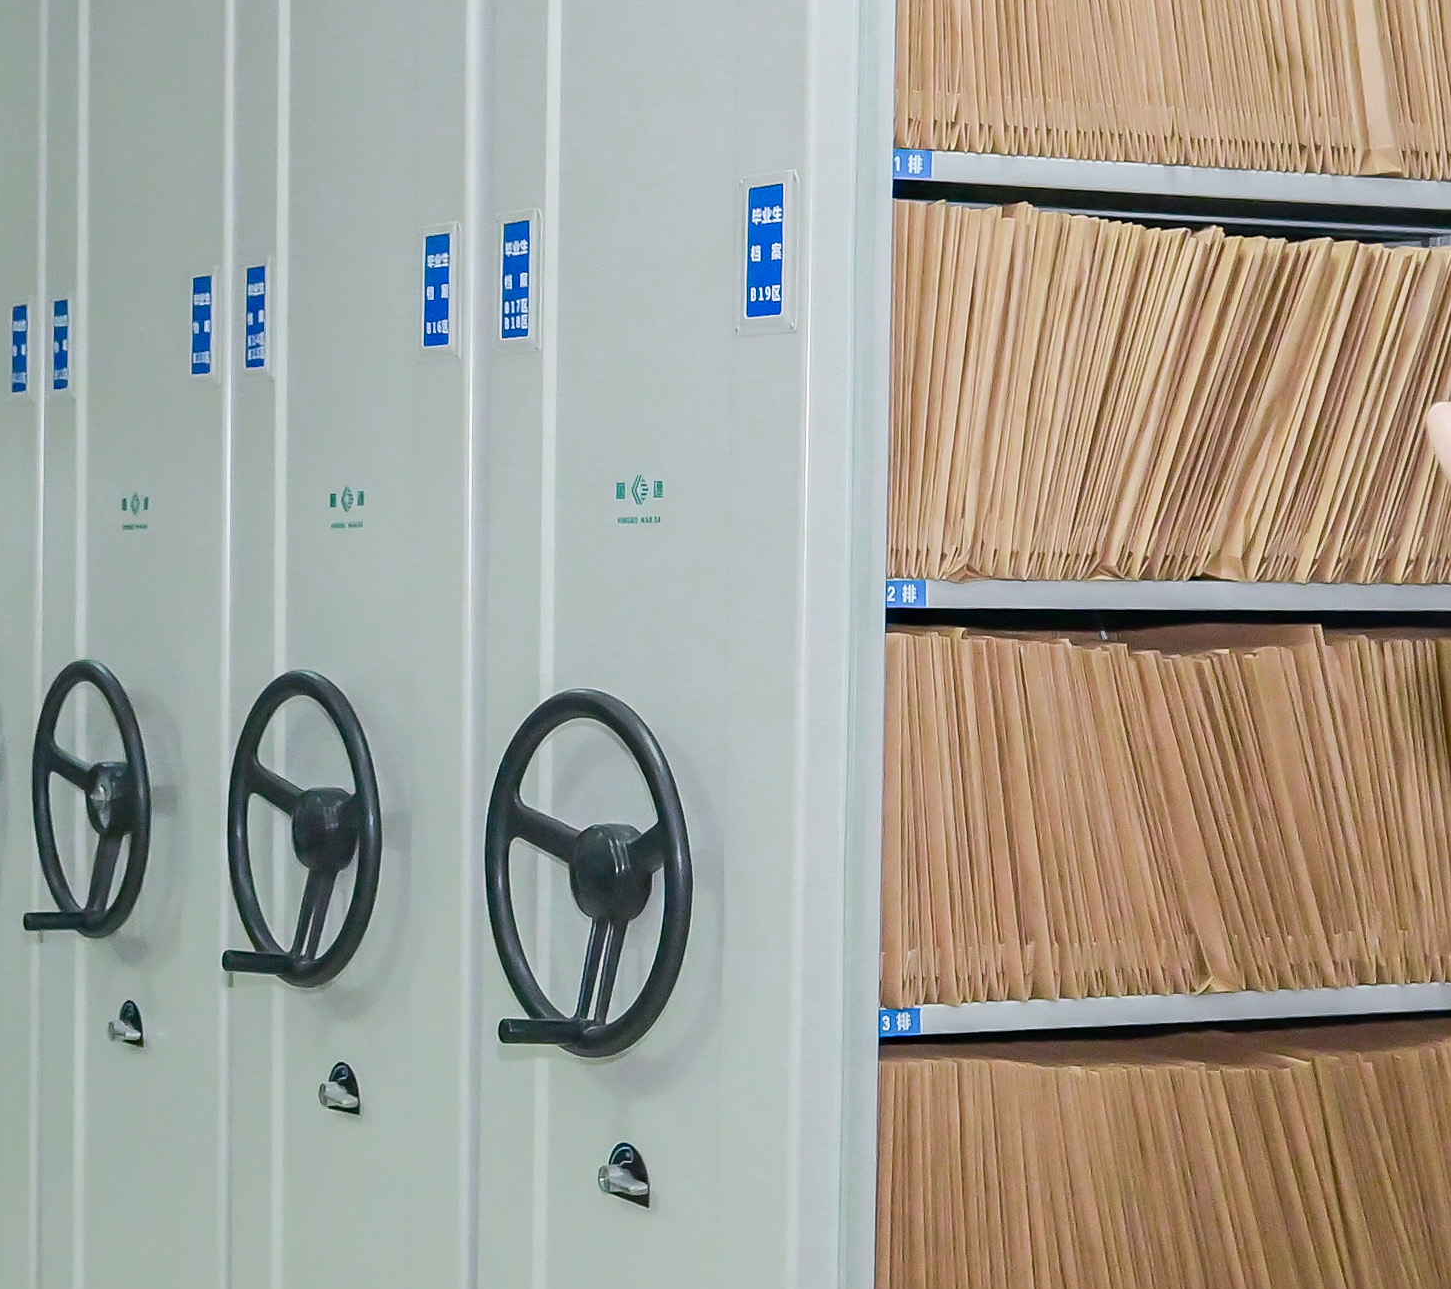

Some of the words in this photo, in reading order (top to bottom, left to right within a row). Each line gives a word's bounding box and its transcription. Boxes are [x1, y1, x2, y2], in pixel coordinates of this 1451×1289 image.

[751, 205, 783, 225] 毕业生
[750, 284, 782, 302] B19区
